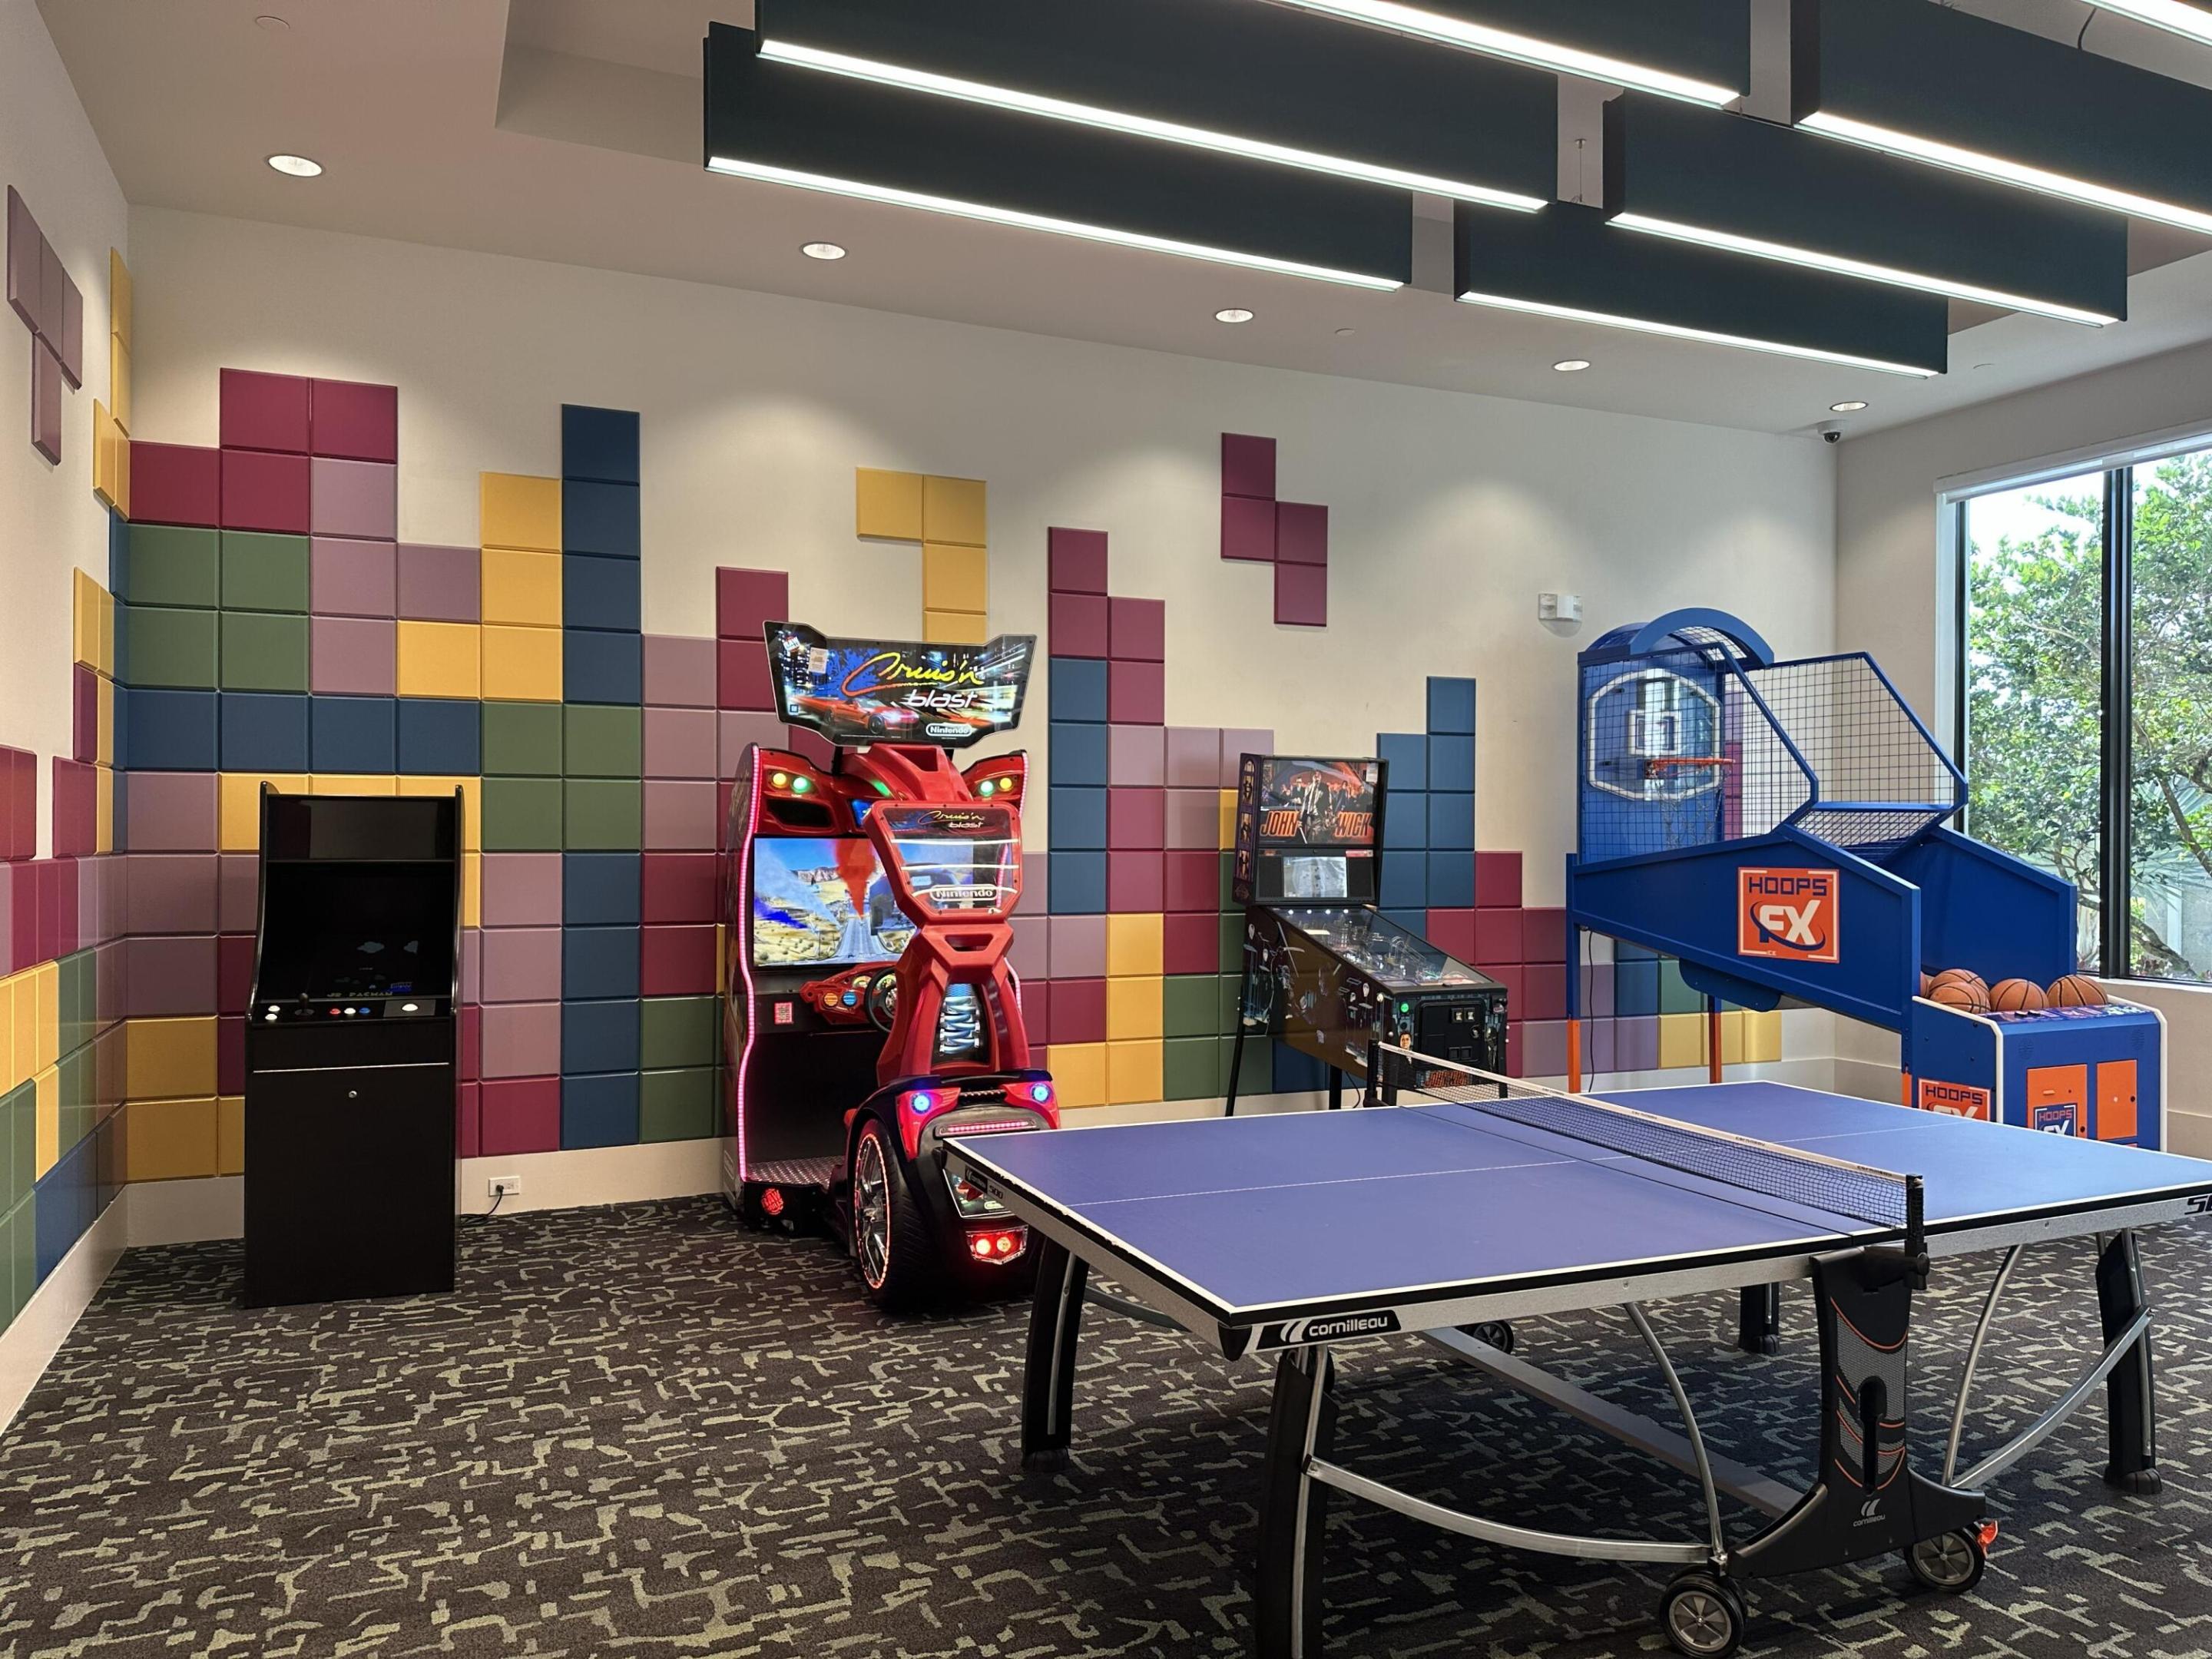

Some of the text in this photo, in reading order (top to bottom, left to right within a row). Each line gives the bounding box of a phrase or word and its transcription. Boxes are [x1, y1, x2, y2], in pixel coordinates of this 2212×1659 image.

[905, 689, 978, 707] blast
[930, 726, 969, 734] Nintendo
[1260, 811, 1373, 838] JOHN WICK
[935, 888, 993, 898] Nintendo
[1749, 877, 1827, 896] HOOPS
[1759, 899, 1821, 945] FX
[1926, 1085, 1982, 1105] HOOPS
[2039, 1109, 2073, 1122] HOOPS
[1309, 1316, 1388, 1336] cornilleau
